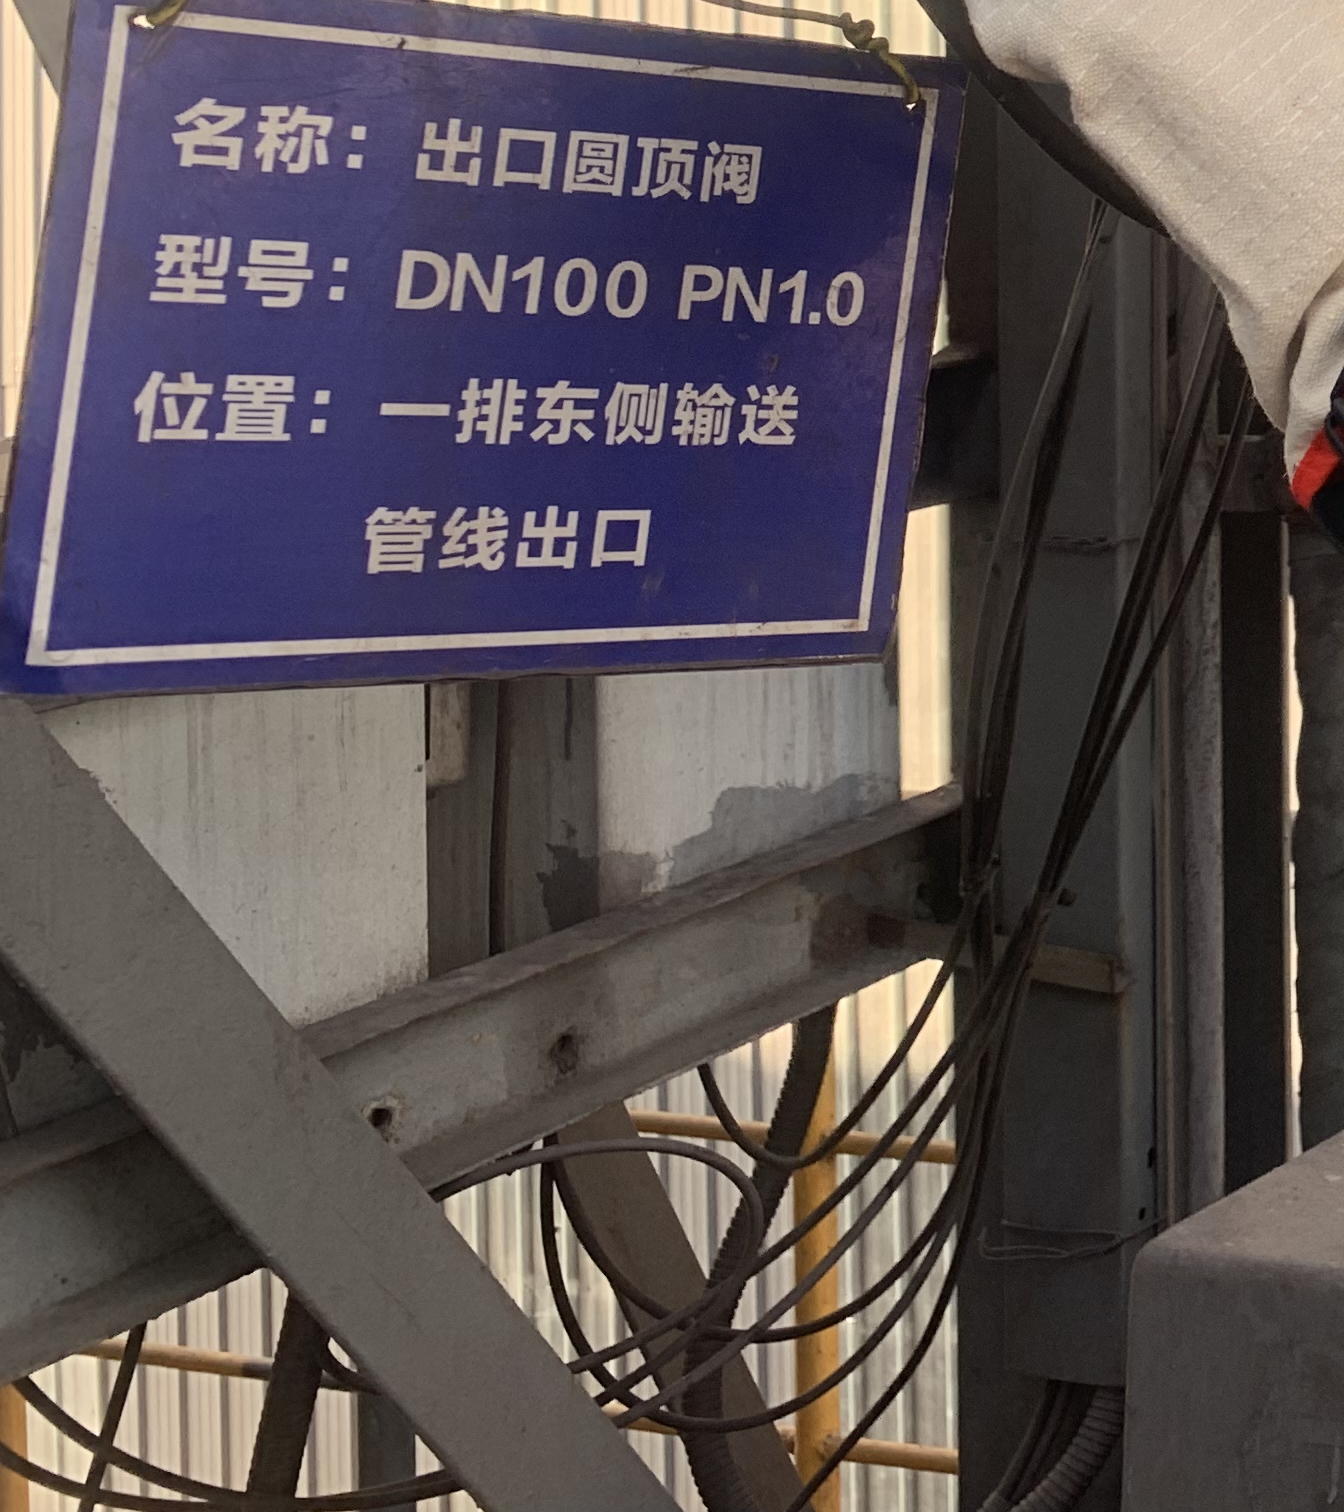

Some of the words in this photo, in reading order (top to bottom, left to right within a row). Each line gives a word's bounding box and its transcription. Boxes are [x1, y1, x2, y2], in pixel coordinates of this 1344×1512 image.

[678, 266, 864, 326] PN1.0
[365, 506, 651, 574] 管线出口
